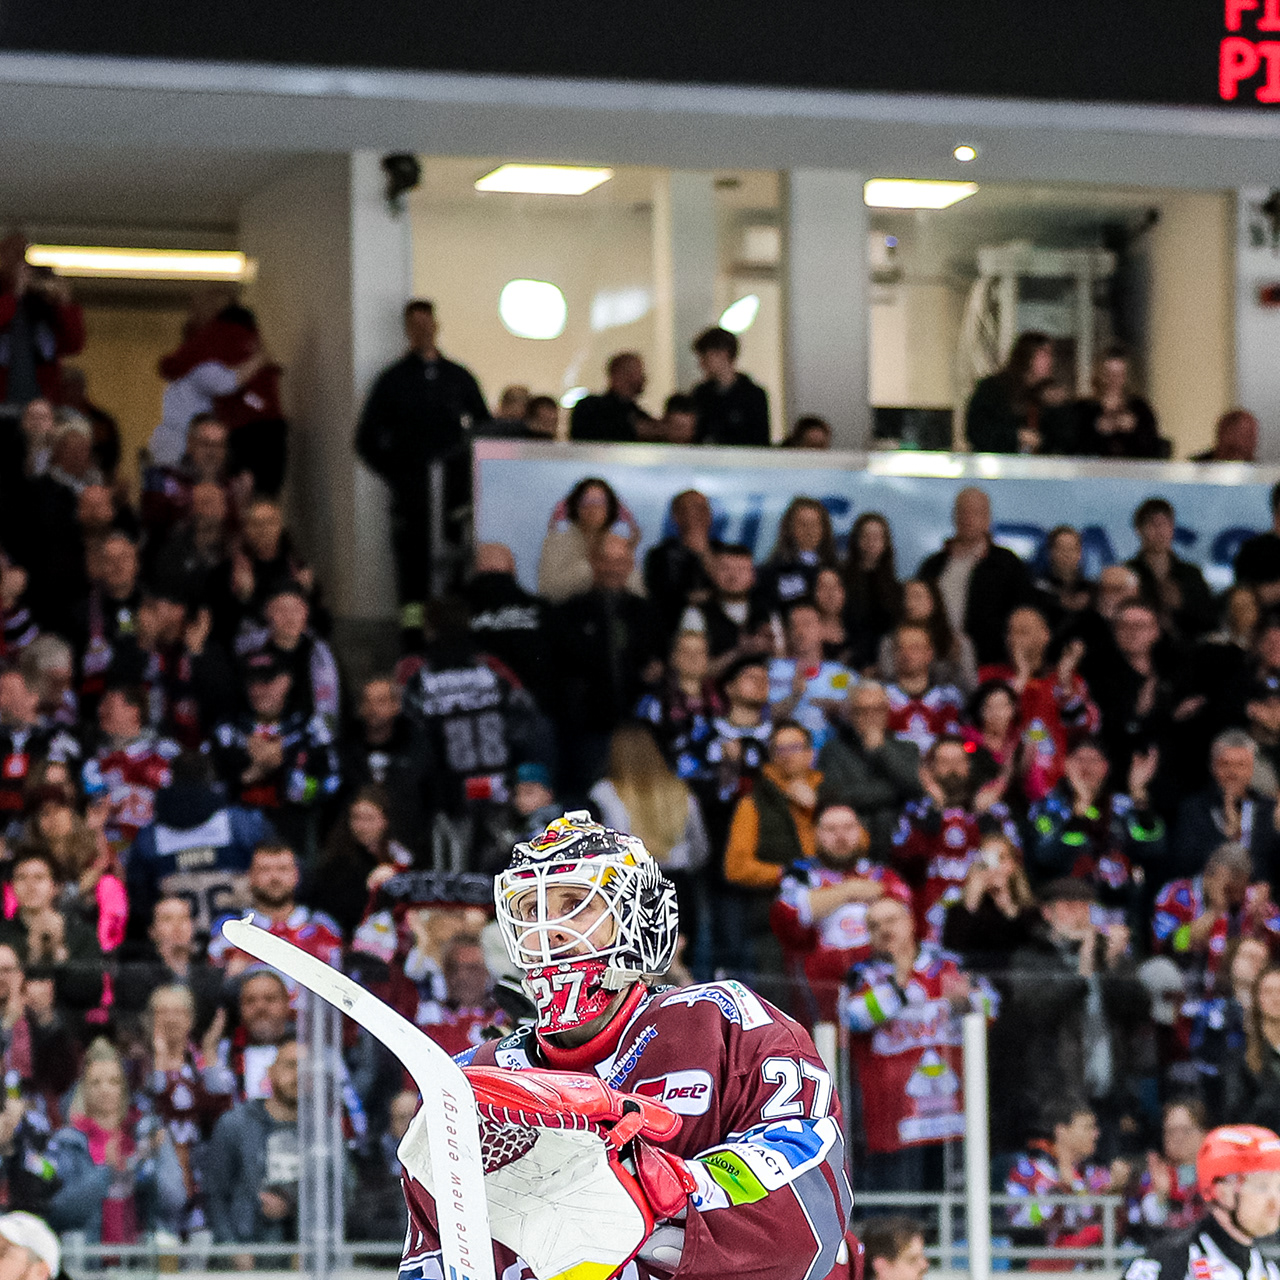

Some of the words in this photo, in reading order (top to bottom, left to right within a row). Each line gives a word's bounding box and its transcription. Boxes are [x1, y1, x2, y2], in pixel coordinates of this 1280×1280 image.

[531, 970, 586, 1029] 27
[760, 1056, 835, 1119] 27
[441, 1088, 459, 1162] energy
[451, 1175, 465, 1212] new
[458, 1223, 475, 1269] pure
